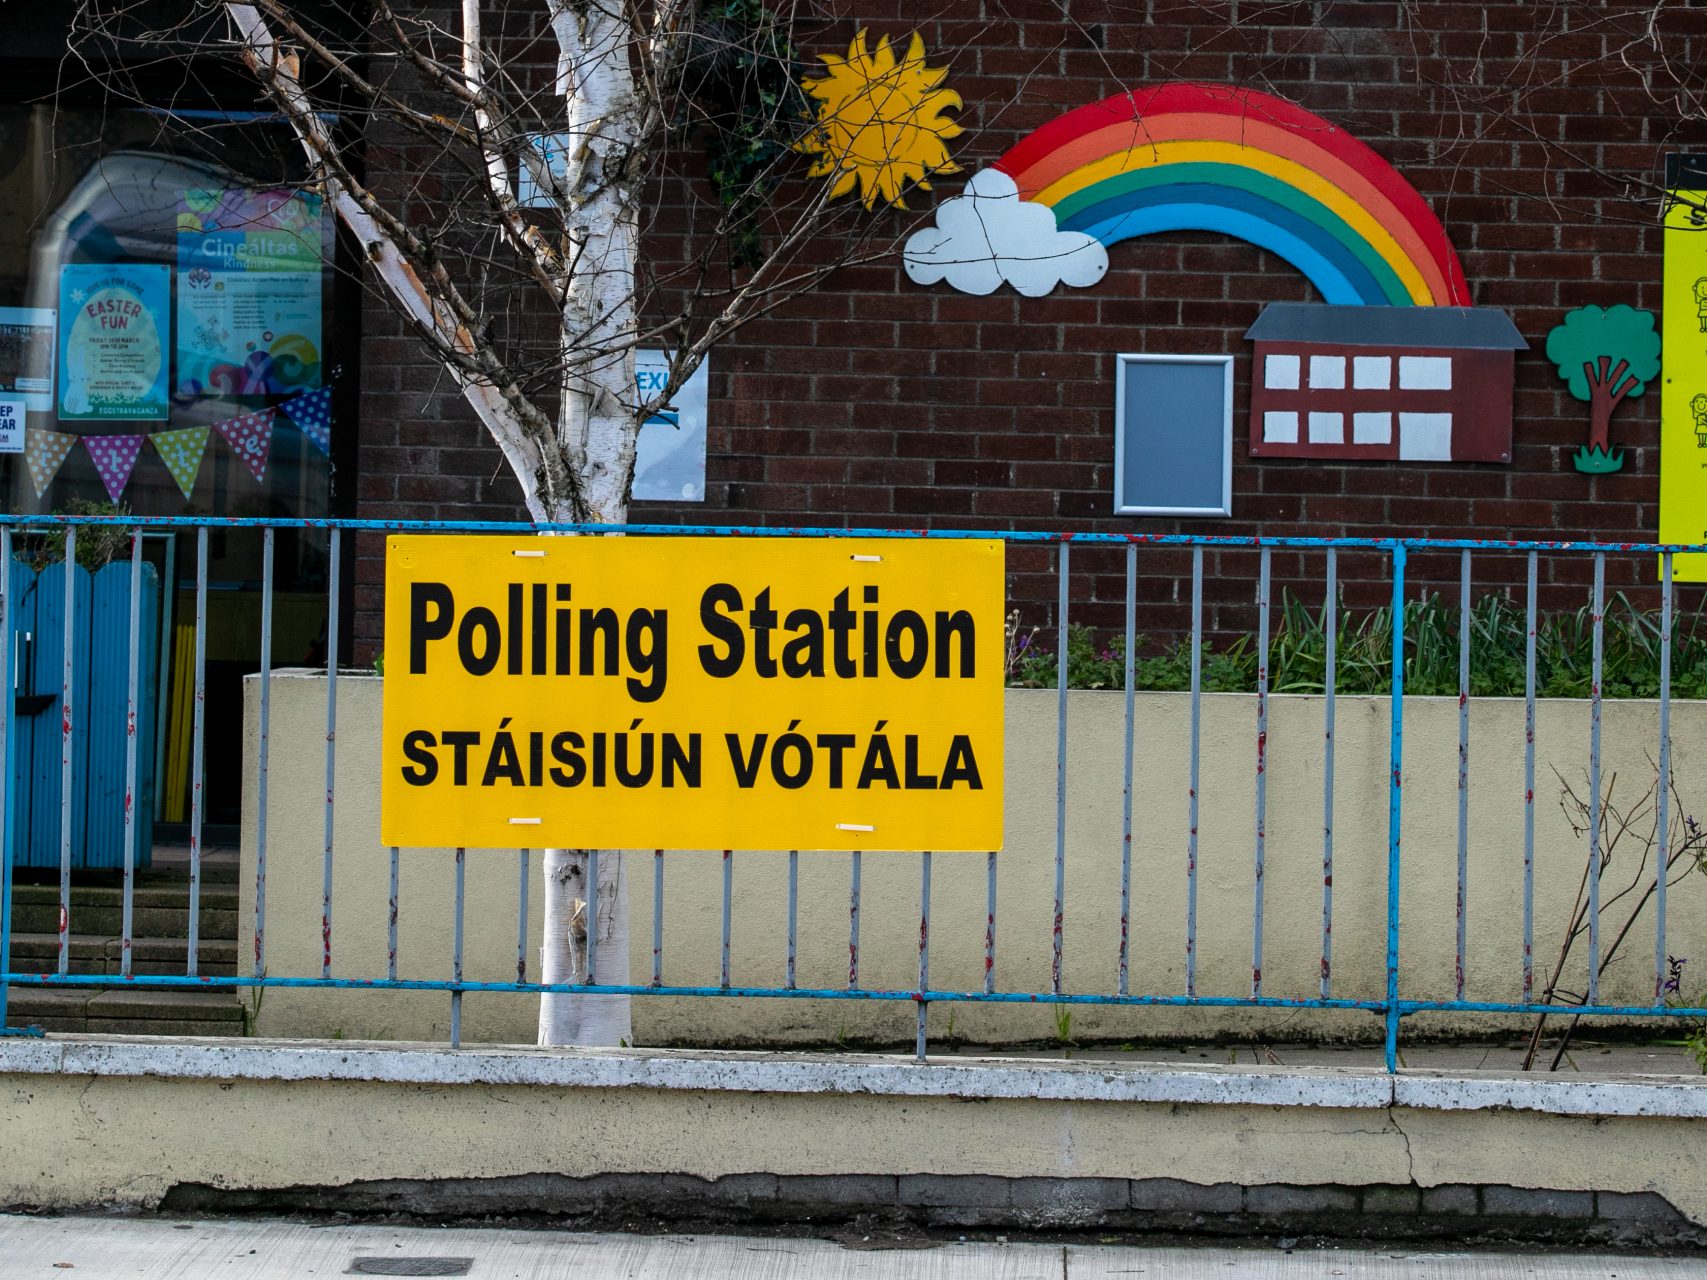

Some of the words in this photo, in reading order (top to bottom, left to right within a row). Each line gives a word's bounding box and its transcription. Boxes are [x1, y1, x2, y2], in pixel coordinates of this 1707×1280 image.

[202, 238, 298, 257] Cineáltas
[224, 258, 276, 269] Kindness
[87, 299, 142, 318] EASTER
[101, 316, 128, 330] FUN
[409, 582, 668, 703] Polling
[697, 583, 976, 680] Station
[401, 717, 702, 789] STÁISIÚN
[724, 719, 984, 790] VÓTÁLA
